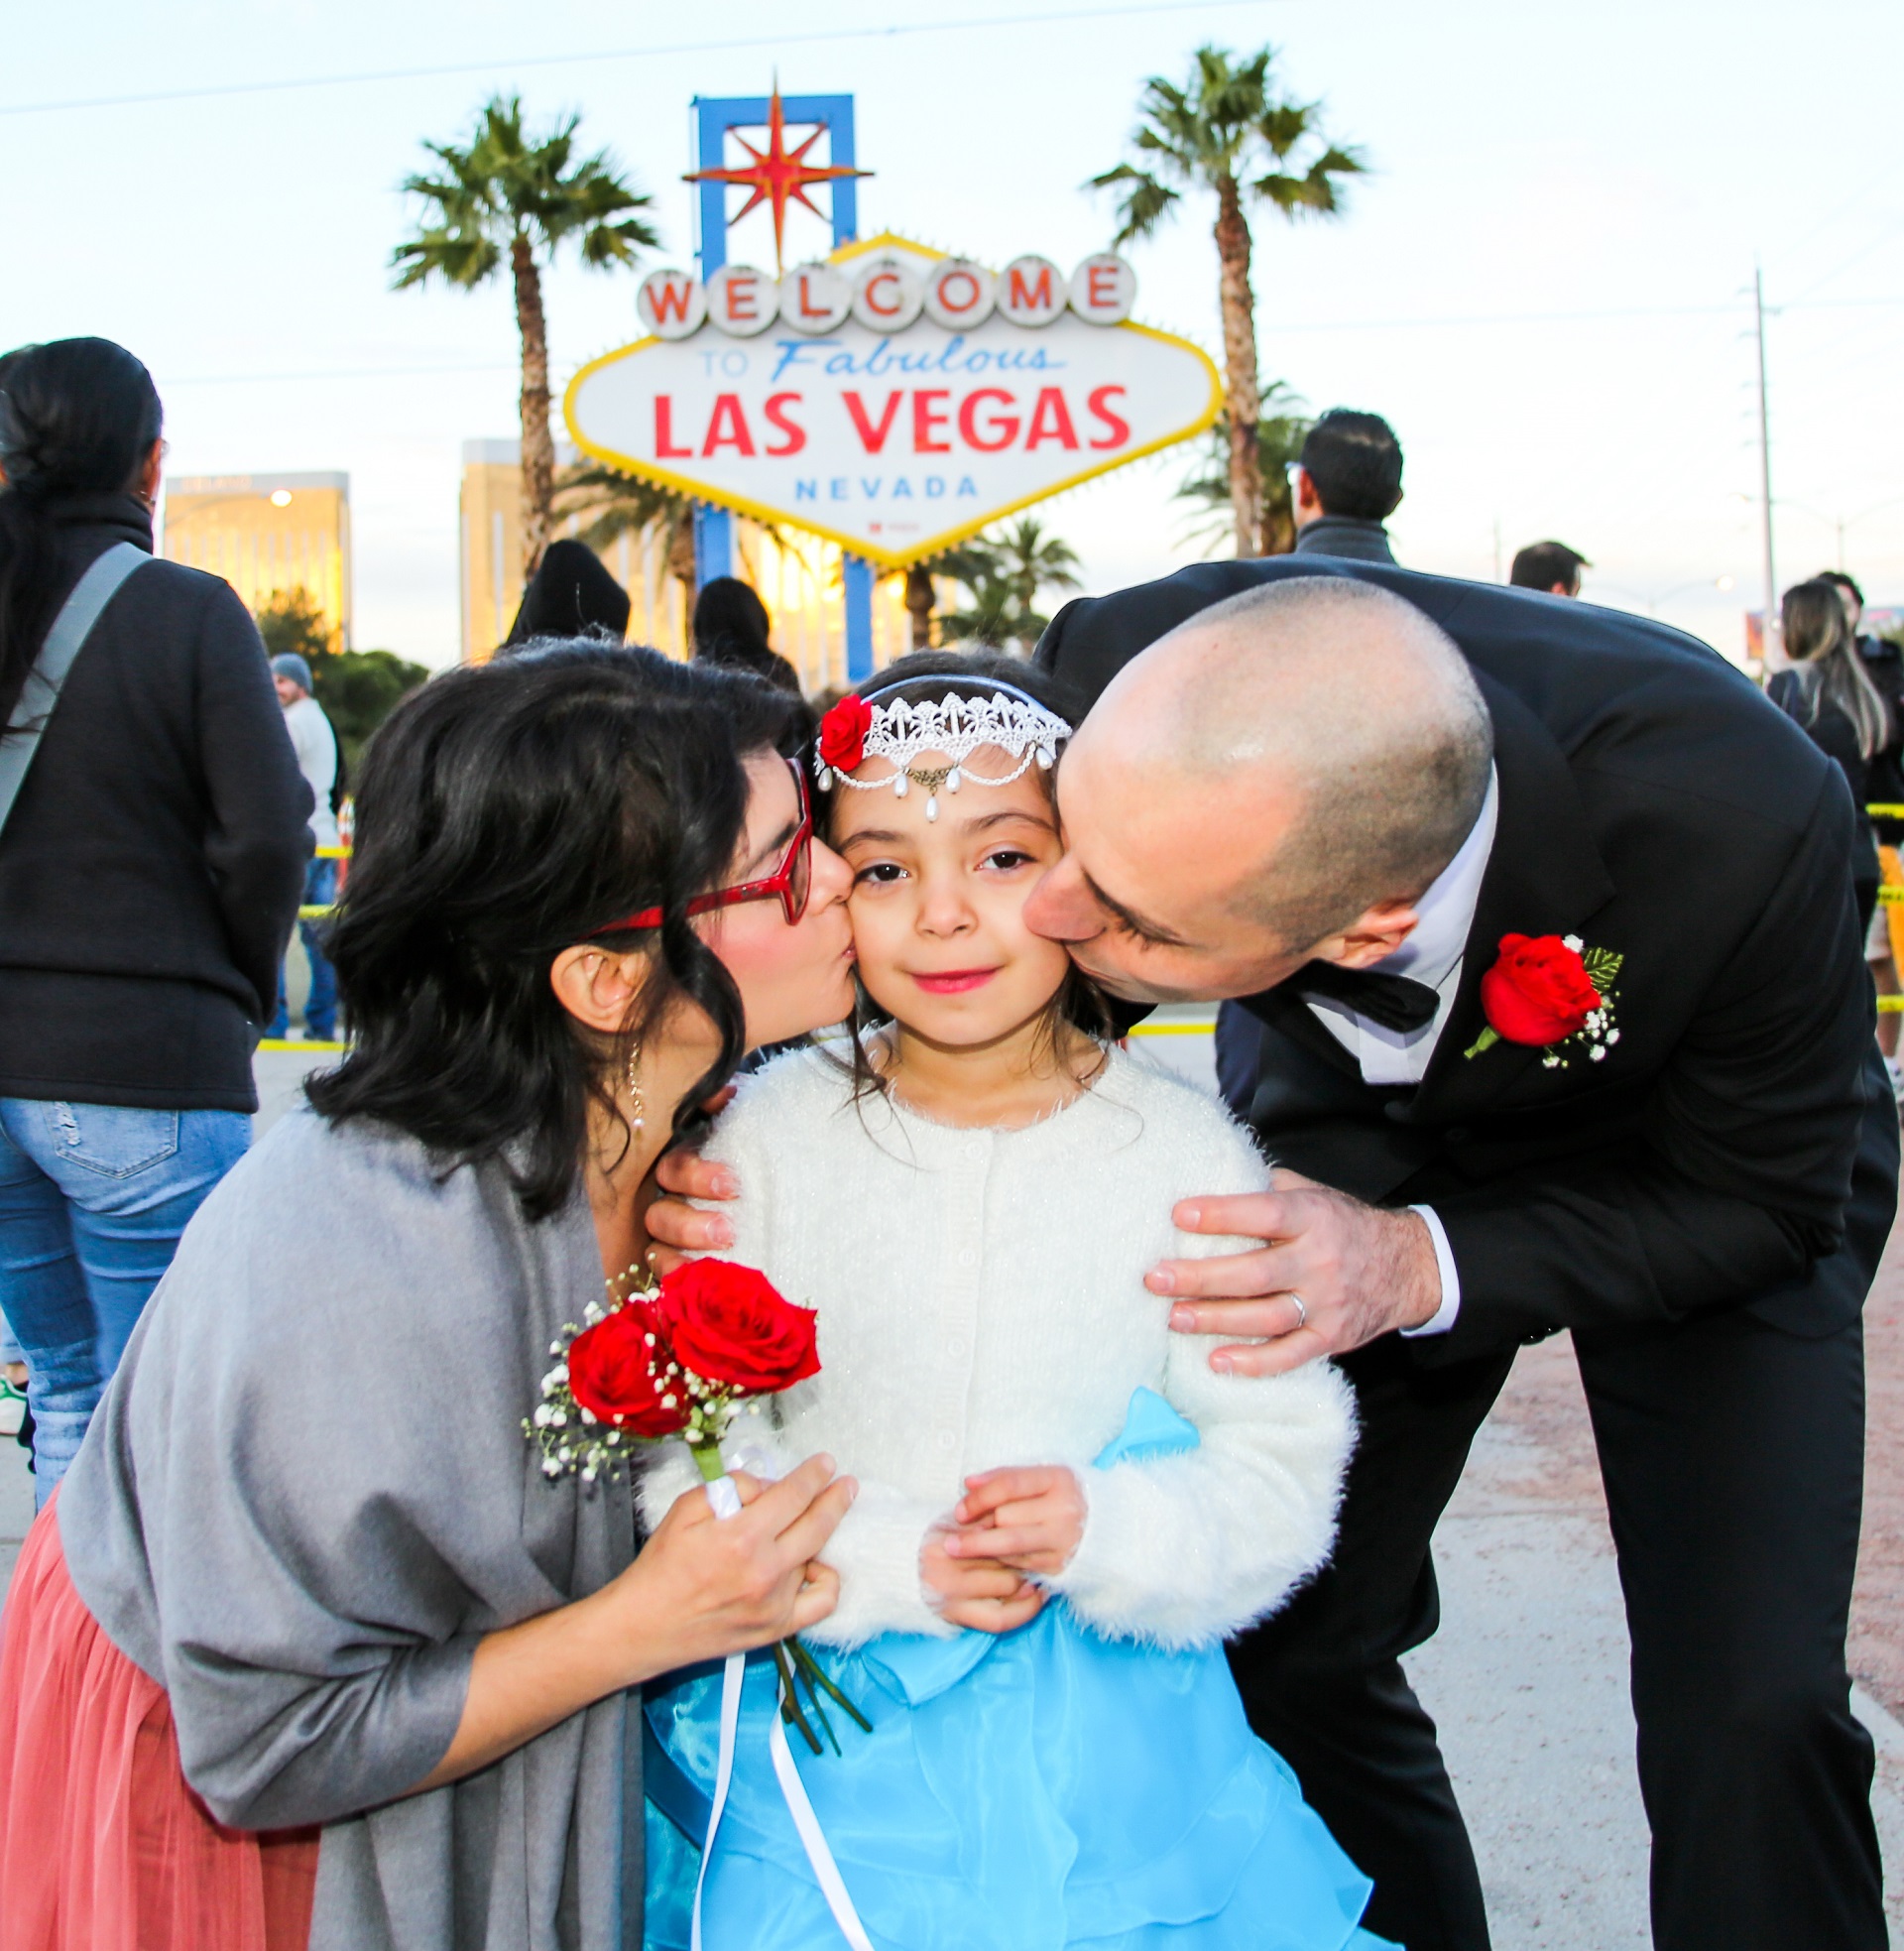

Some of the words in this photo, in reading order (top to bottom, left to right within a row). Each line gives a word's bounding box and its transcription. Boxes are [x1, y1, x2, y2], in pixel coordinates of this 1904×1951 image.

[646, 265, 1119, 325] WELCOME
[701, 349, 750, 377] TO
[771, 335, 1065, 383] Fabulous
[654, 391, 807, 459] LAS
[842, 384, 1130, 454] VEGAS
[794, 475, 979, 502] NEVADA
